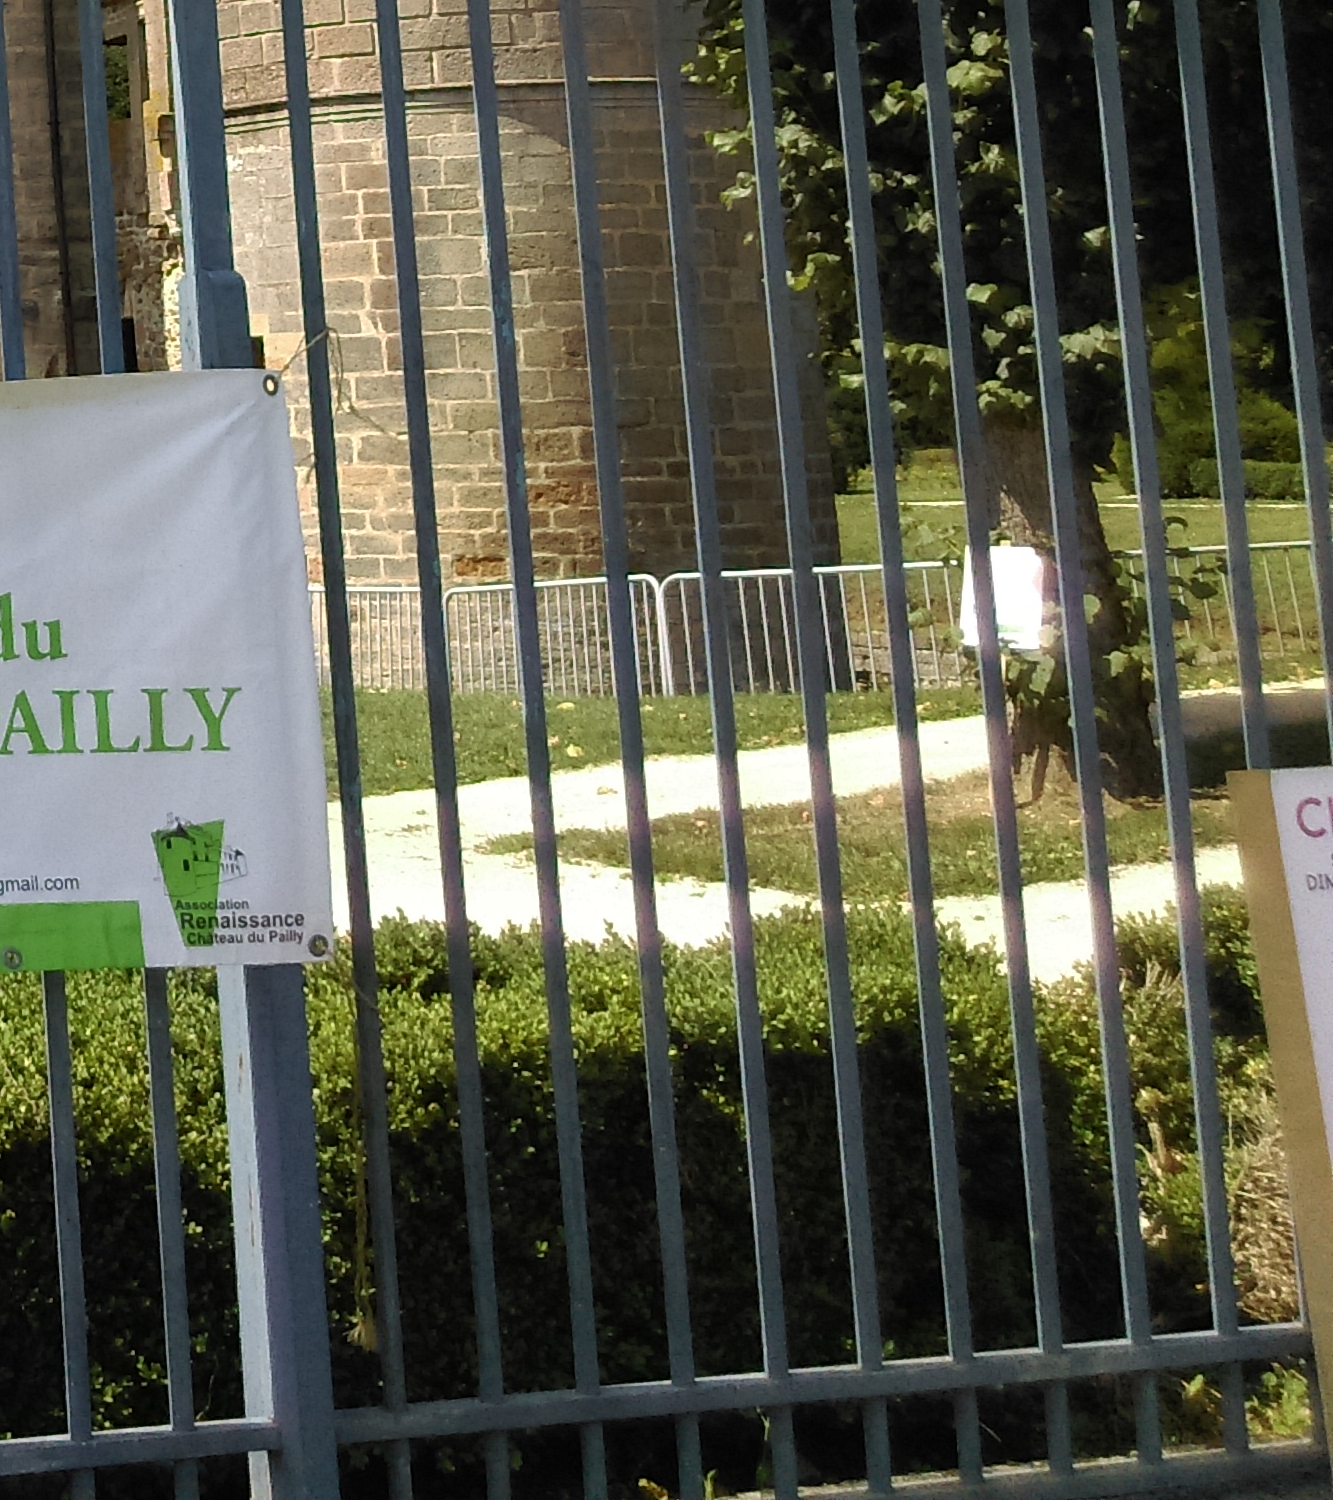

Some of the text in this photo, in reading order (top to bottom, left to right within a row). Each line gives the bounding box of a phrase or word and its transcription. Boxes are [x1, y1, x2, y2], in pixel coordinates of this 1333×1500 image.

[175, 899, 249, 911] Association
[180, 911, 305, 930] Renaissance
[248, 931, 264, 943] du
[269, 930, 304, 945] Pailly
